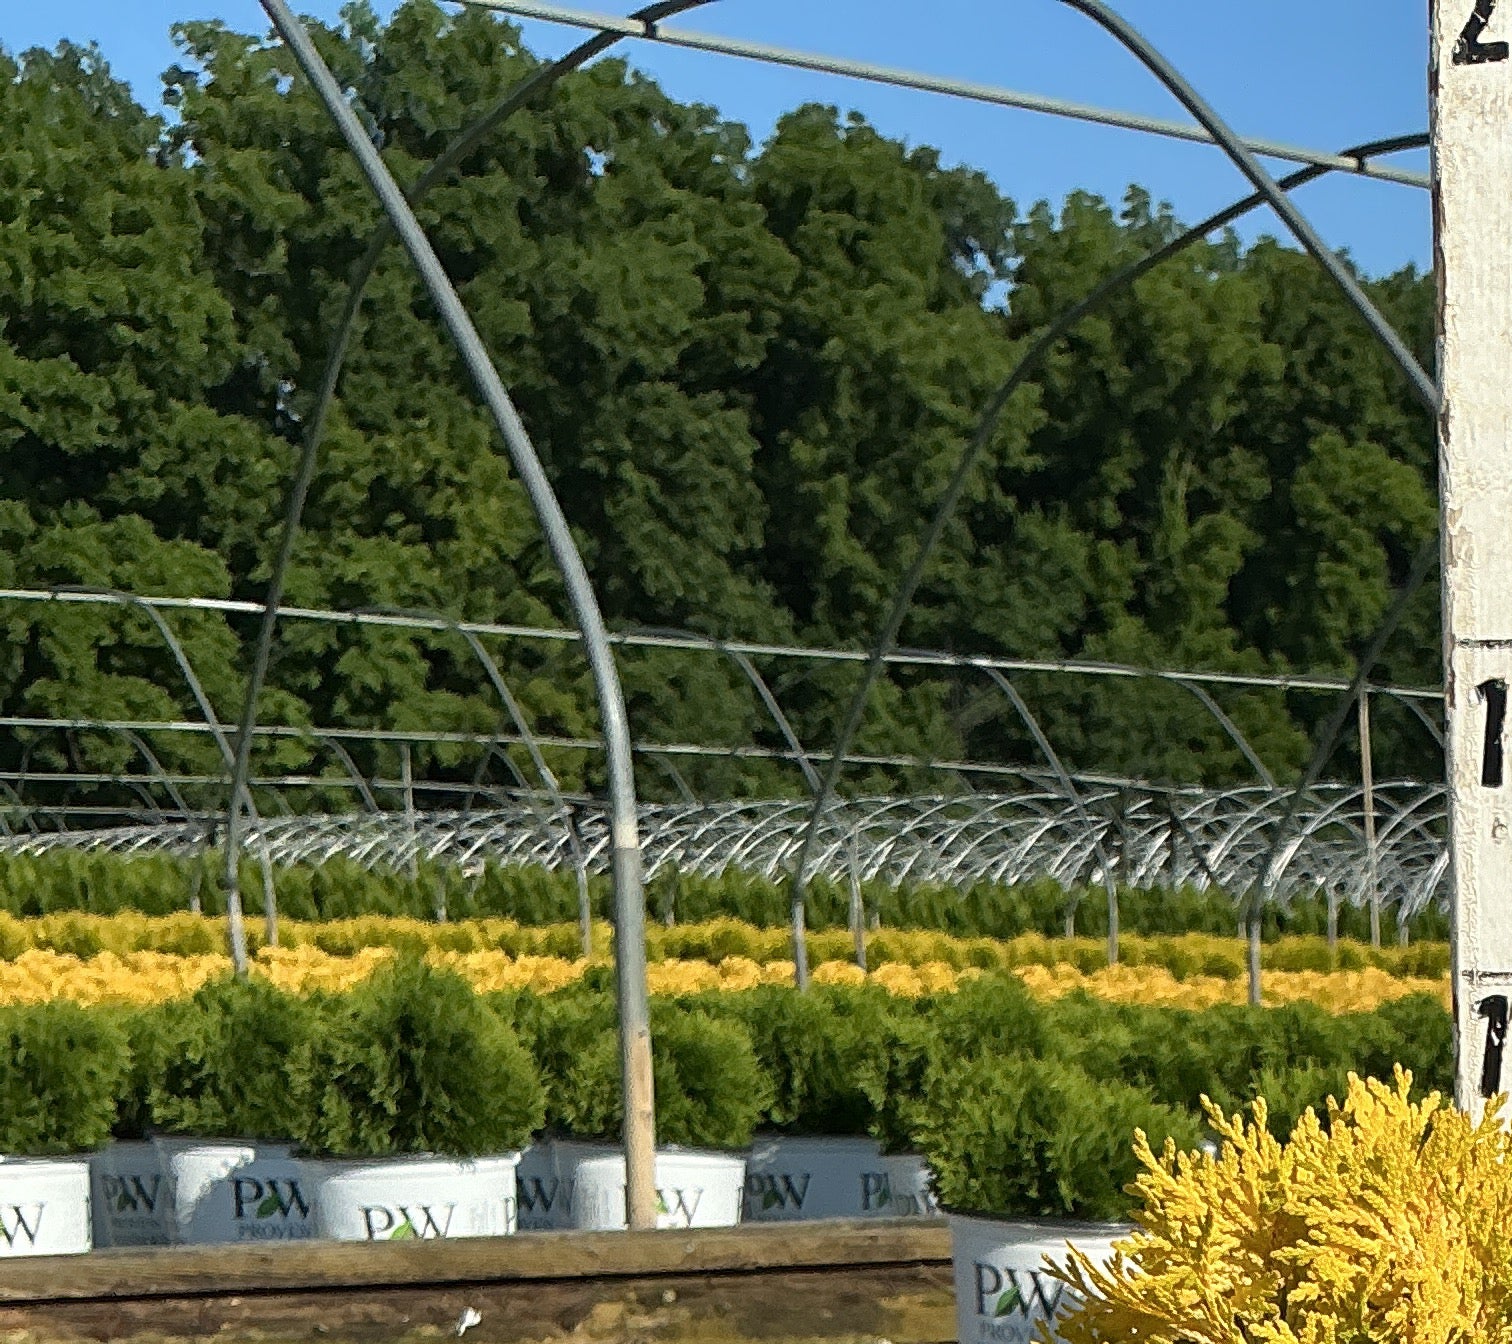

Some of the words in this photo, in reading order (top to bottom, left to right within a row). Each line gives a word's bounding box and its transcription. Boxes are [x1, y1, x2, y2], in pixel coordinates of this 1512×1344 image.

[231, 1175, 312, 1221] PW
[358, 1202, 456, 1241] PW
[972, 1259, 1067, 1321] PW
